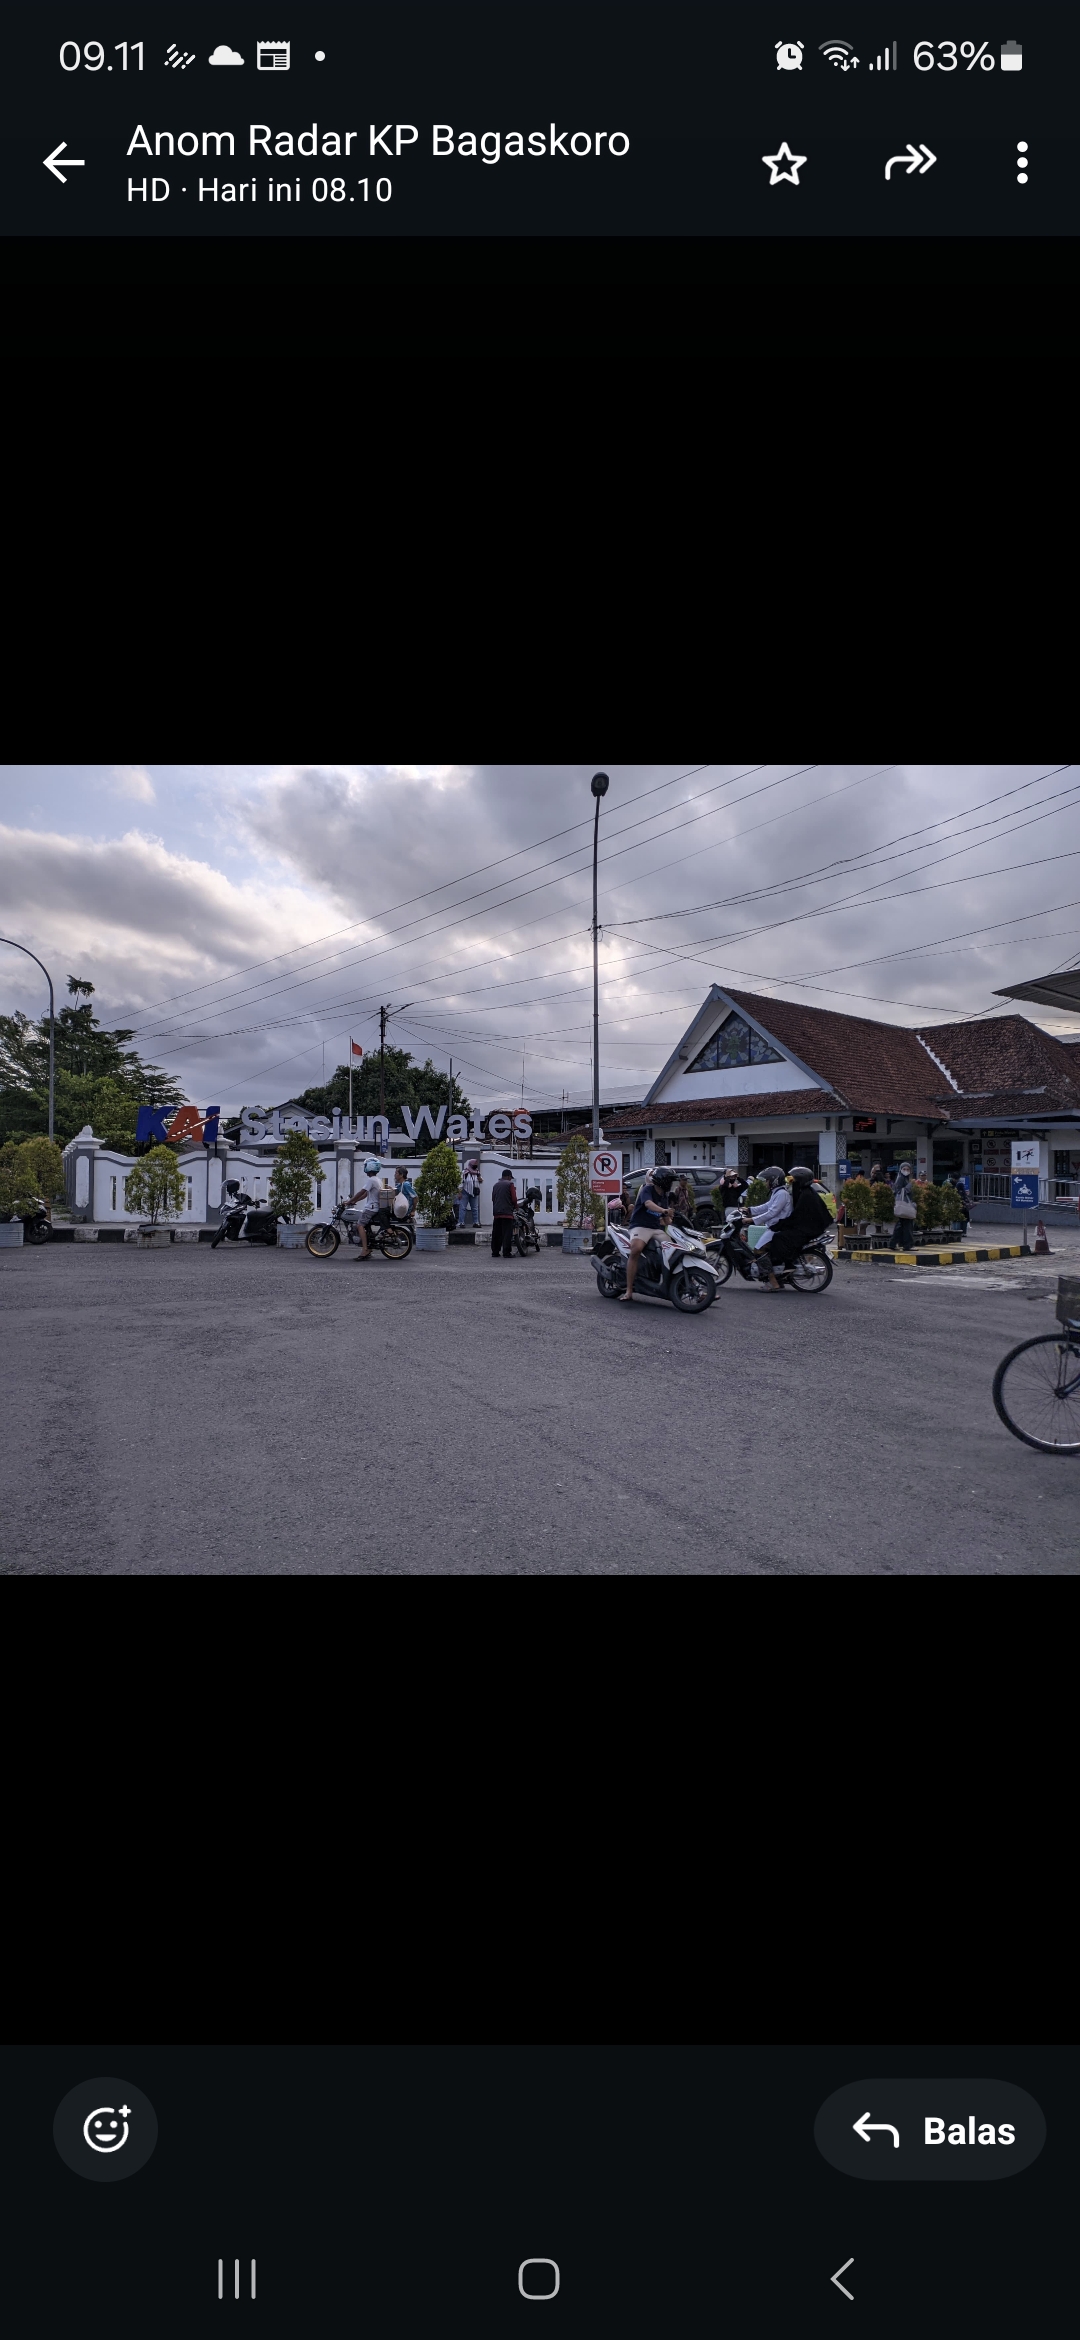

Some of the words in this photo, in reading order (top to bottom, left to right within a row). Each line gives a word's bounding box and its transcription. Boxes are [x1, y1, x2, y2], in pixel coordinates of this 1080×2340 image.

[136, 1106, 220, 1142] KAI
[240, 1107, 389, 1142] Stasiun
[400, 1105, 533, 1140] Wates
[601, 1158, 611, 1171] P
